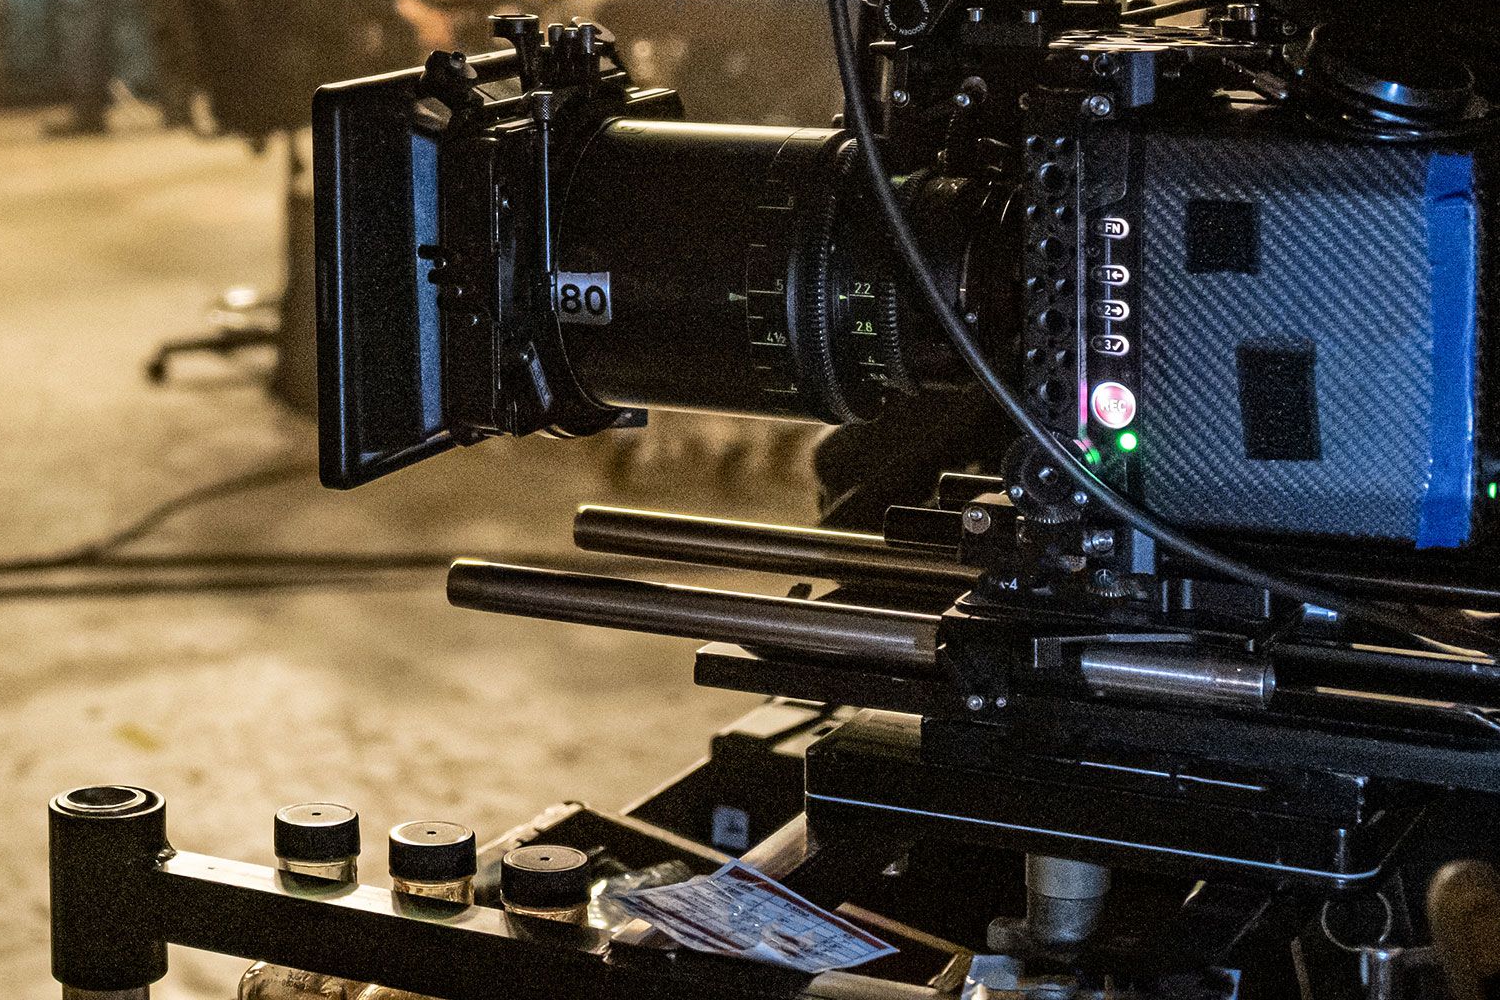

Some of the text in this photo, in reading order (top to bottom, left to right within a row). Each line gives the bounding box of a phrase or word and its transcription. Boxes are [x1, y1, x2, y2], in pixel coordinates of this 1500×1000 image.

[1105, 223, 1121, 234] FN
[1105, 269, 1111, 280] 1
[776, 279, 784, 292] 5
[854, 281, 872, 295] 2.2
[560, 284, 607, 315] 80
[1104, 305, 1111, 316] 2
[855, 321, 873, 333] 2.8
[1104, 340, 1111, 351] 3
[1100, 399, 1128, 412] REC
